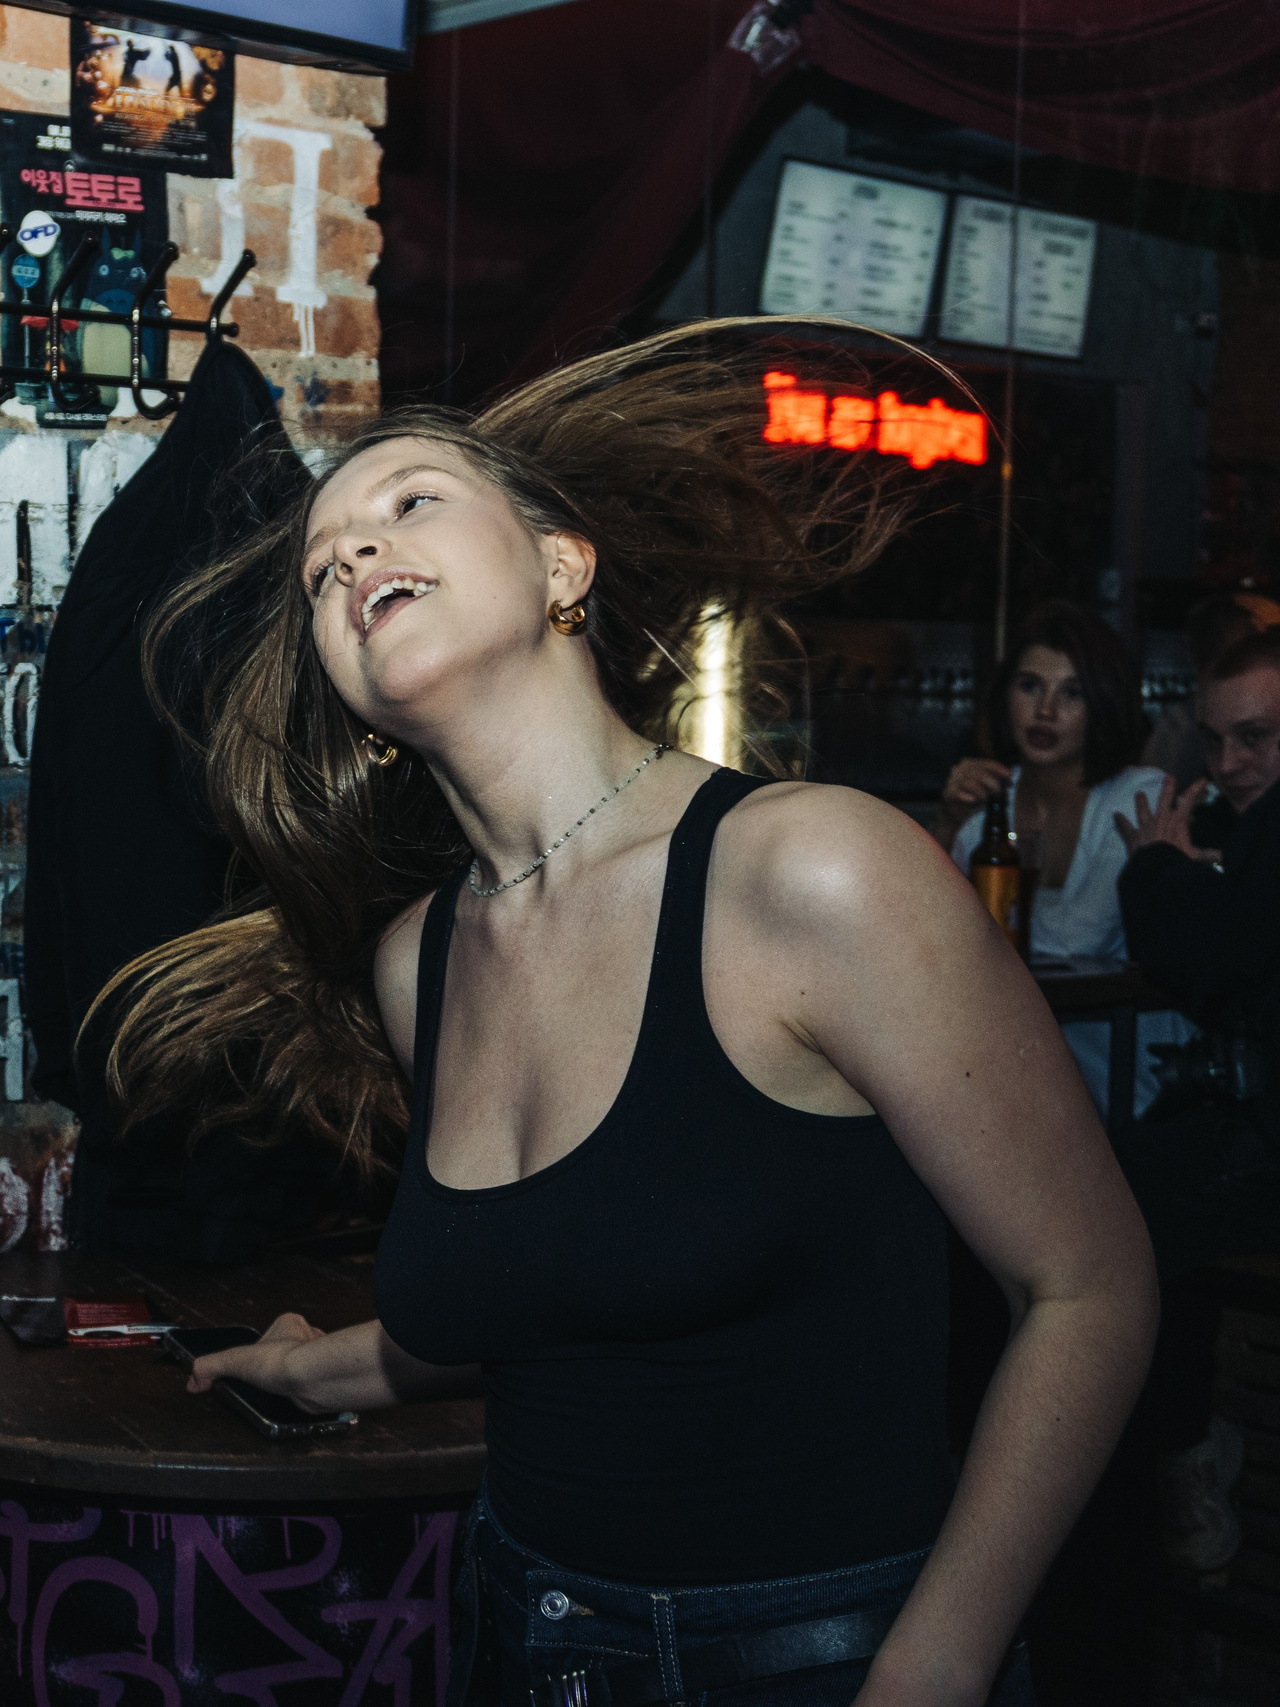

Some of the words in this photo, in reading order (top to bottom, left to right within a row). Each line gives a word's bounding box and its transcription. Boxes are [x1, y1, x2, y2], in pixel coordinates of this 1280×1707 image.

[20, 169, 63, 195] 이웃집
[65, 171, 145, 211] 토토로
[19, 223, 58, 241] OFD
